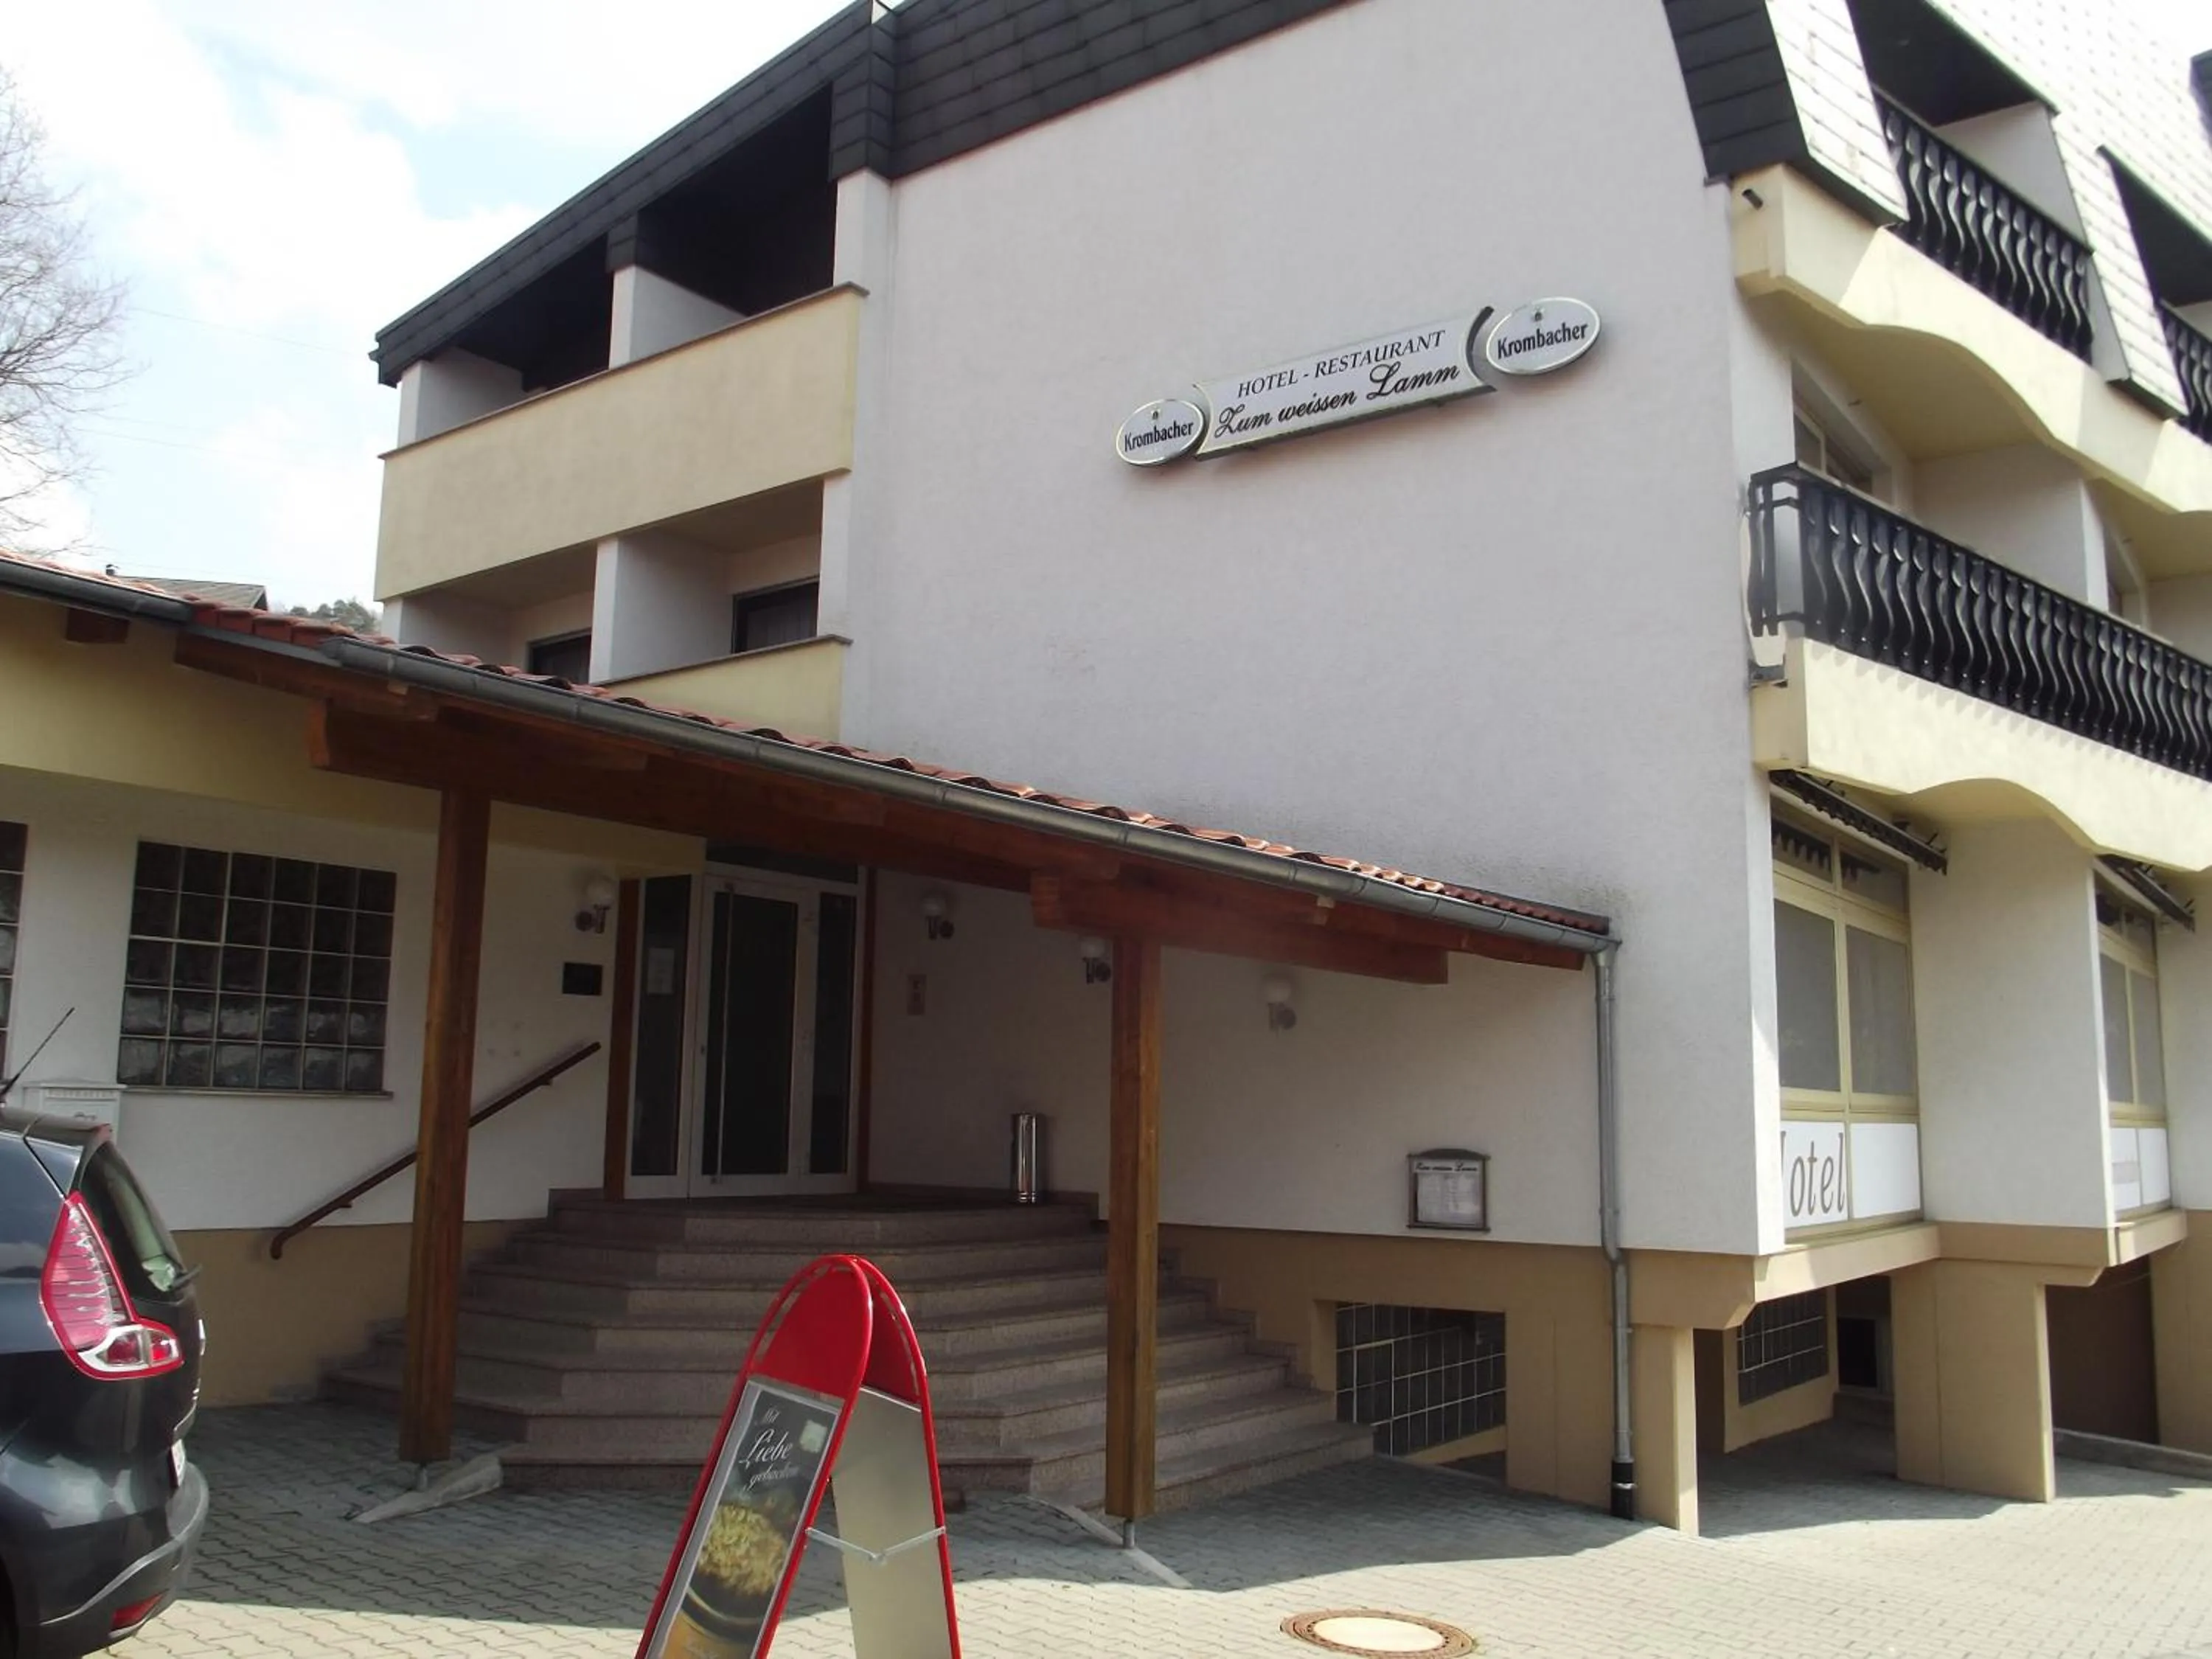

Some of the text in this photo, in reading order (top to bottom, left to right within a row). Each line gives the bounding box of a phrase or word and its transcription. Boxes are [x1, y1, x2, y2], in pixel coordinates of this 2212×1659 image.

[1237, 370, 1298, 398] HOTEL
[1315, 330, 1445, 378] RESTAURANT
[1498, 321, 1588, 360] Krombacher
[1214, 361, 1460, 438] Zum weissen Lamm
[1124, 420, 1194, 452] Krombacher
[1781, 1130, 1845, 1217] otel
